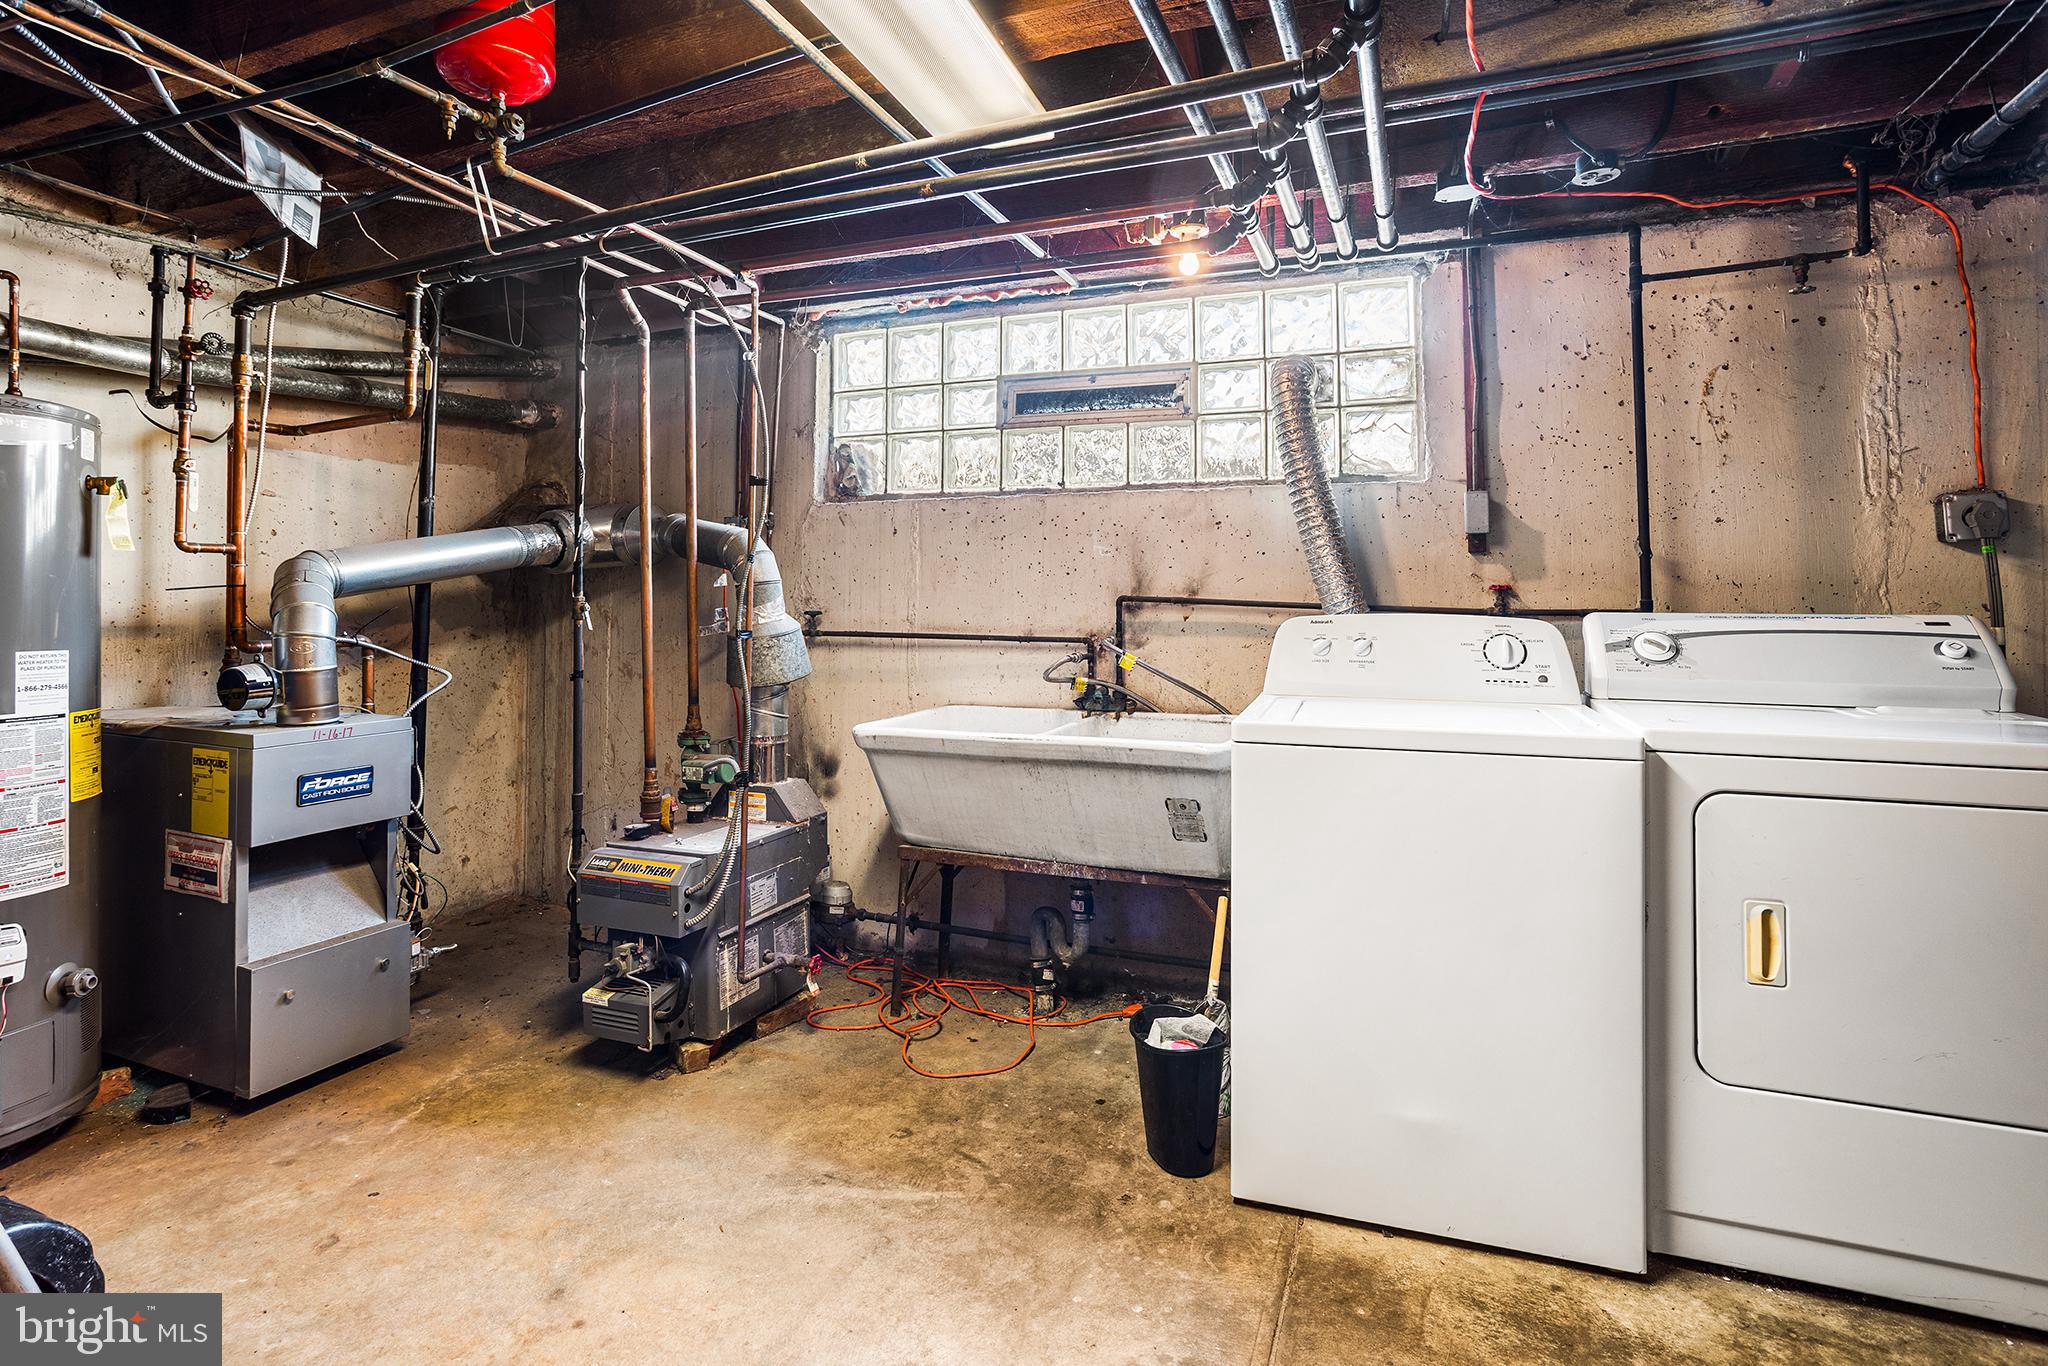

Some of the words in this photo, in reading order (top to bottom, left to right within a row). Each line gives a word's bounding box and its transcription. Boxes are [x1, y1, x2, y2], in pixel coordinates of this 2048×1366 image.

[312, 726, 353, 740] 11-16-17
[302, 772, 371, 792] FORCE
[302, 791, 323, 800] CAST
[323, 788, 341, 796] IRON
[342, 783, 369, 793] BOILERS
